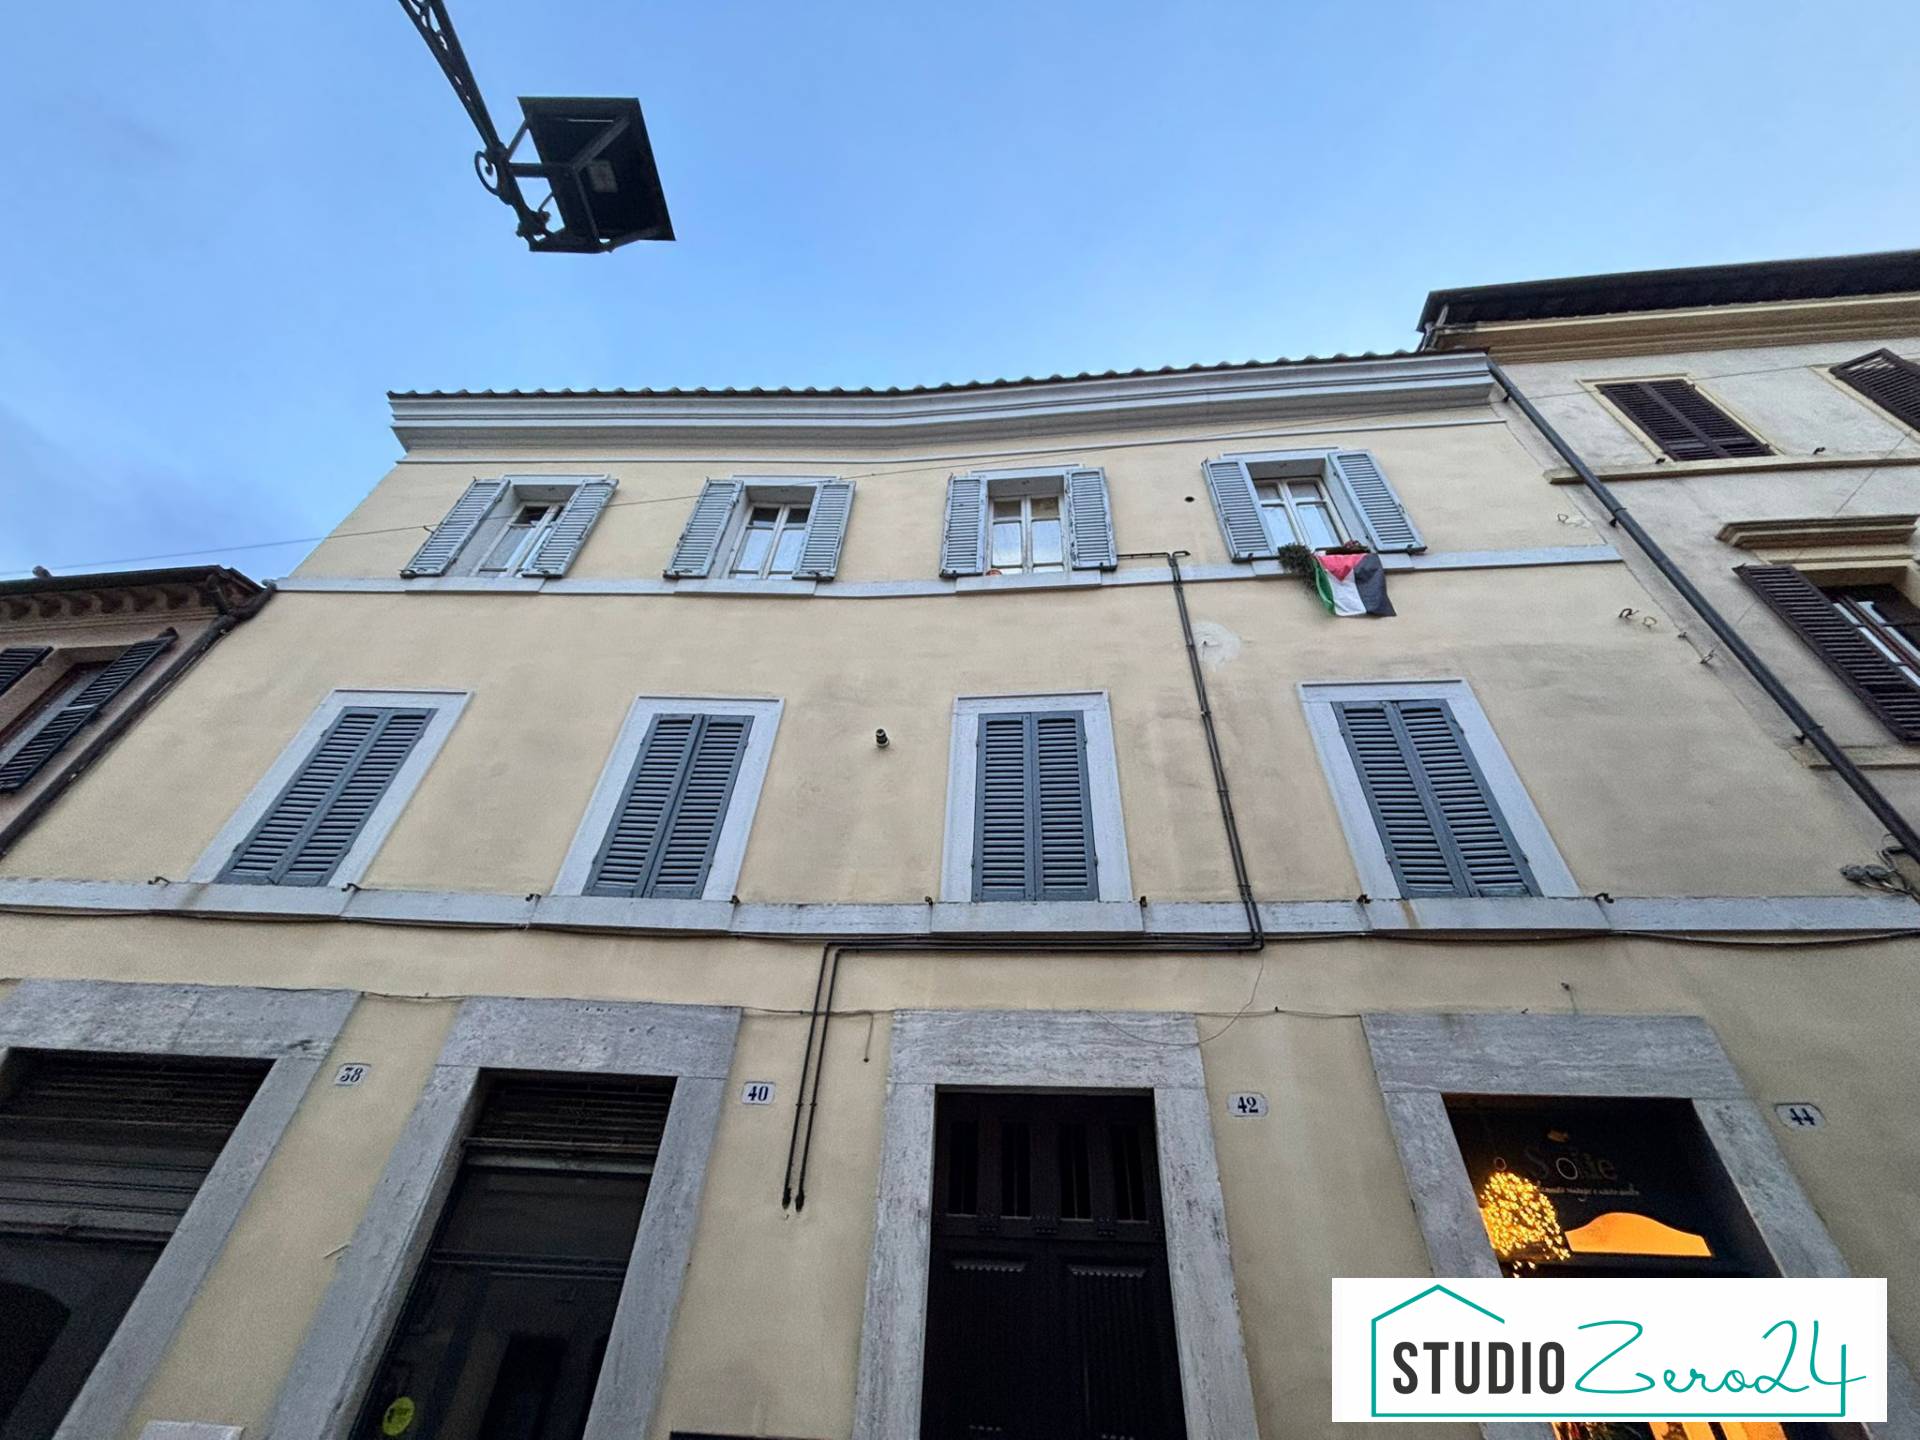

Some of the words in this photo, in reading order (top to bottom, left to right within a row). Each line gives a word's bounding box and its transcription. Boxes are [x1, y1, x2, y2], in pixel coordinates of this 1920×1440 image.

[340, 1067, 364, 1082] 38
[748, 1085, 769, 1101] 40
[1237, 1096, 1259, 1113] 42
[1789, 1107, 1815, 1126] 44
